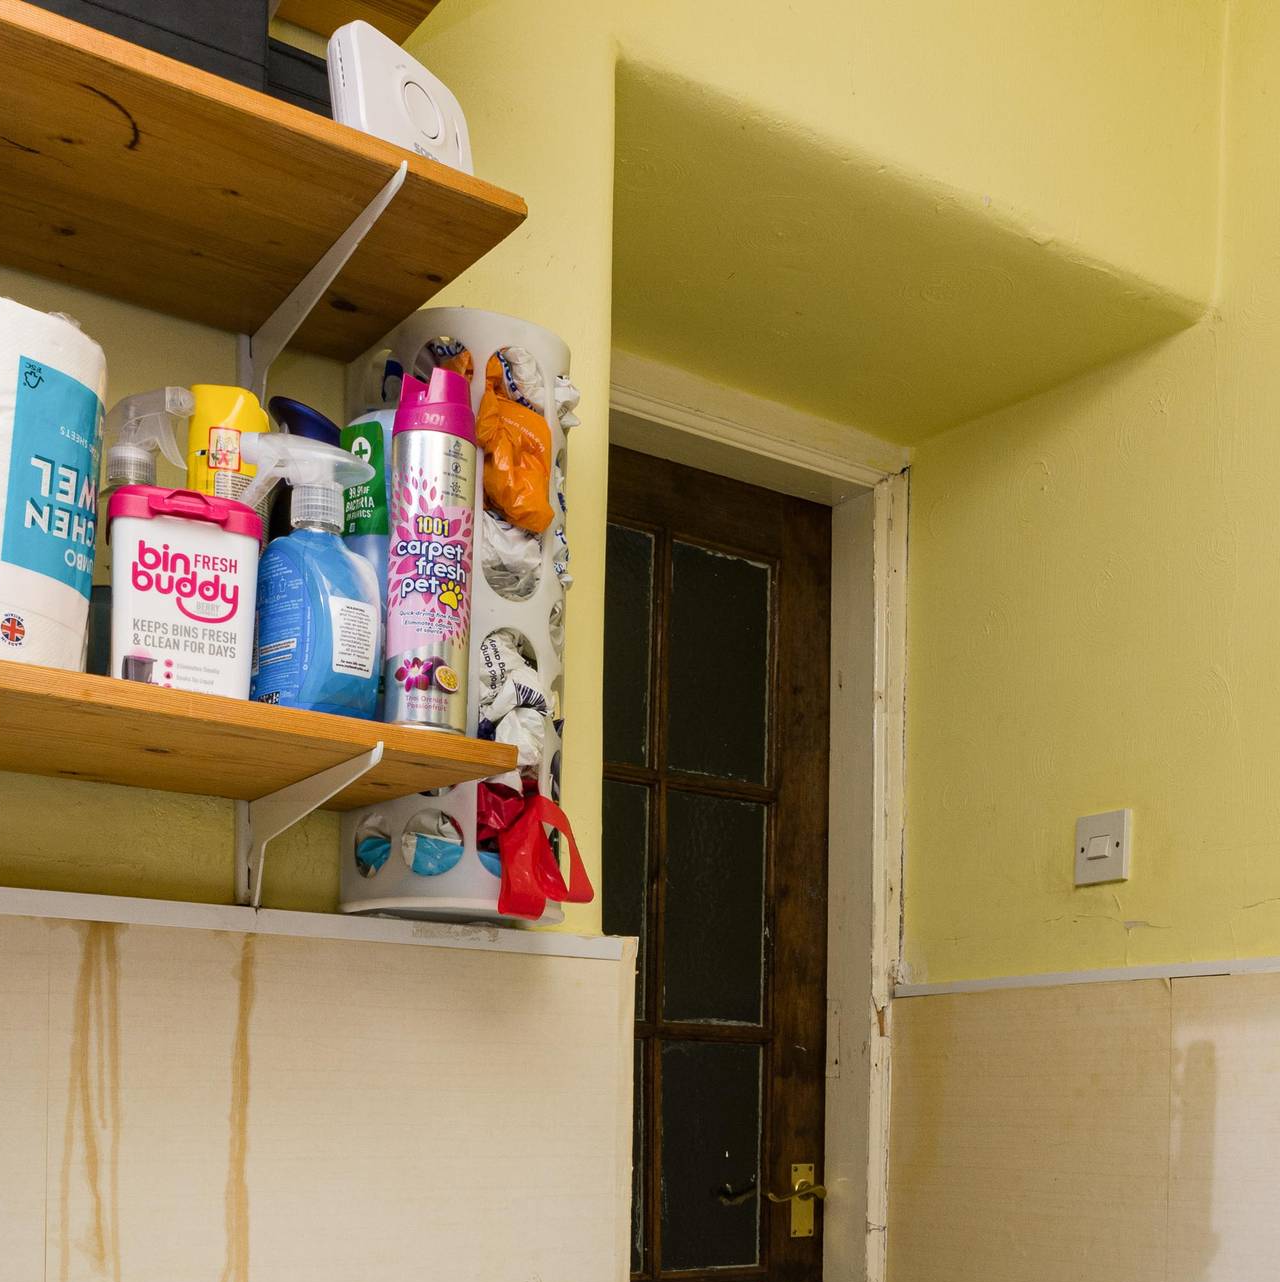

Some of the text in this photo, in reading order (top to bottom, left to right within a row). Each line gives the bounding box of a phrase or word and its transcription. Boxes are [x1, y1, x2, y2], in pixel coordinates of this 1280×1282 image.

[59, 425, 89, 450] SHEETS
[30, 457, 97, 513] WEL
[24, 498, 97, 547] CHEN
[416, 515, 450, 538] 1001
[64, 549, 94, 577] UMBO
[138, 540, 191, 576] bin
[194, 553, 238, 575] FRESH
[396, 540, 464, 562] carpet
[415, 556, 466, 584] fresh
[131, 561, 239, 614] buddy
[400, 576, 440, 599] pet
[195, 600, 221, 613] BERRY
[132, 617, 238, 645] KEEPS BINS FRESH
[132, 632, 237, 659] & CLEAN FOR DAYS
[489, 639, 500, 661] away
